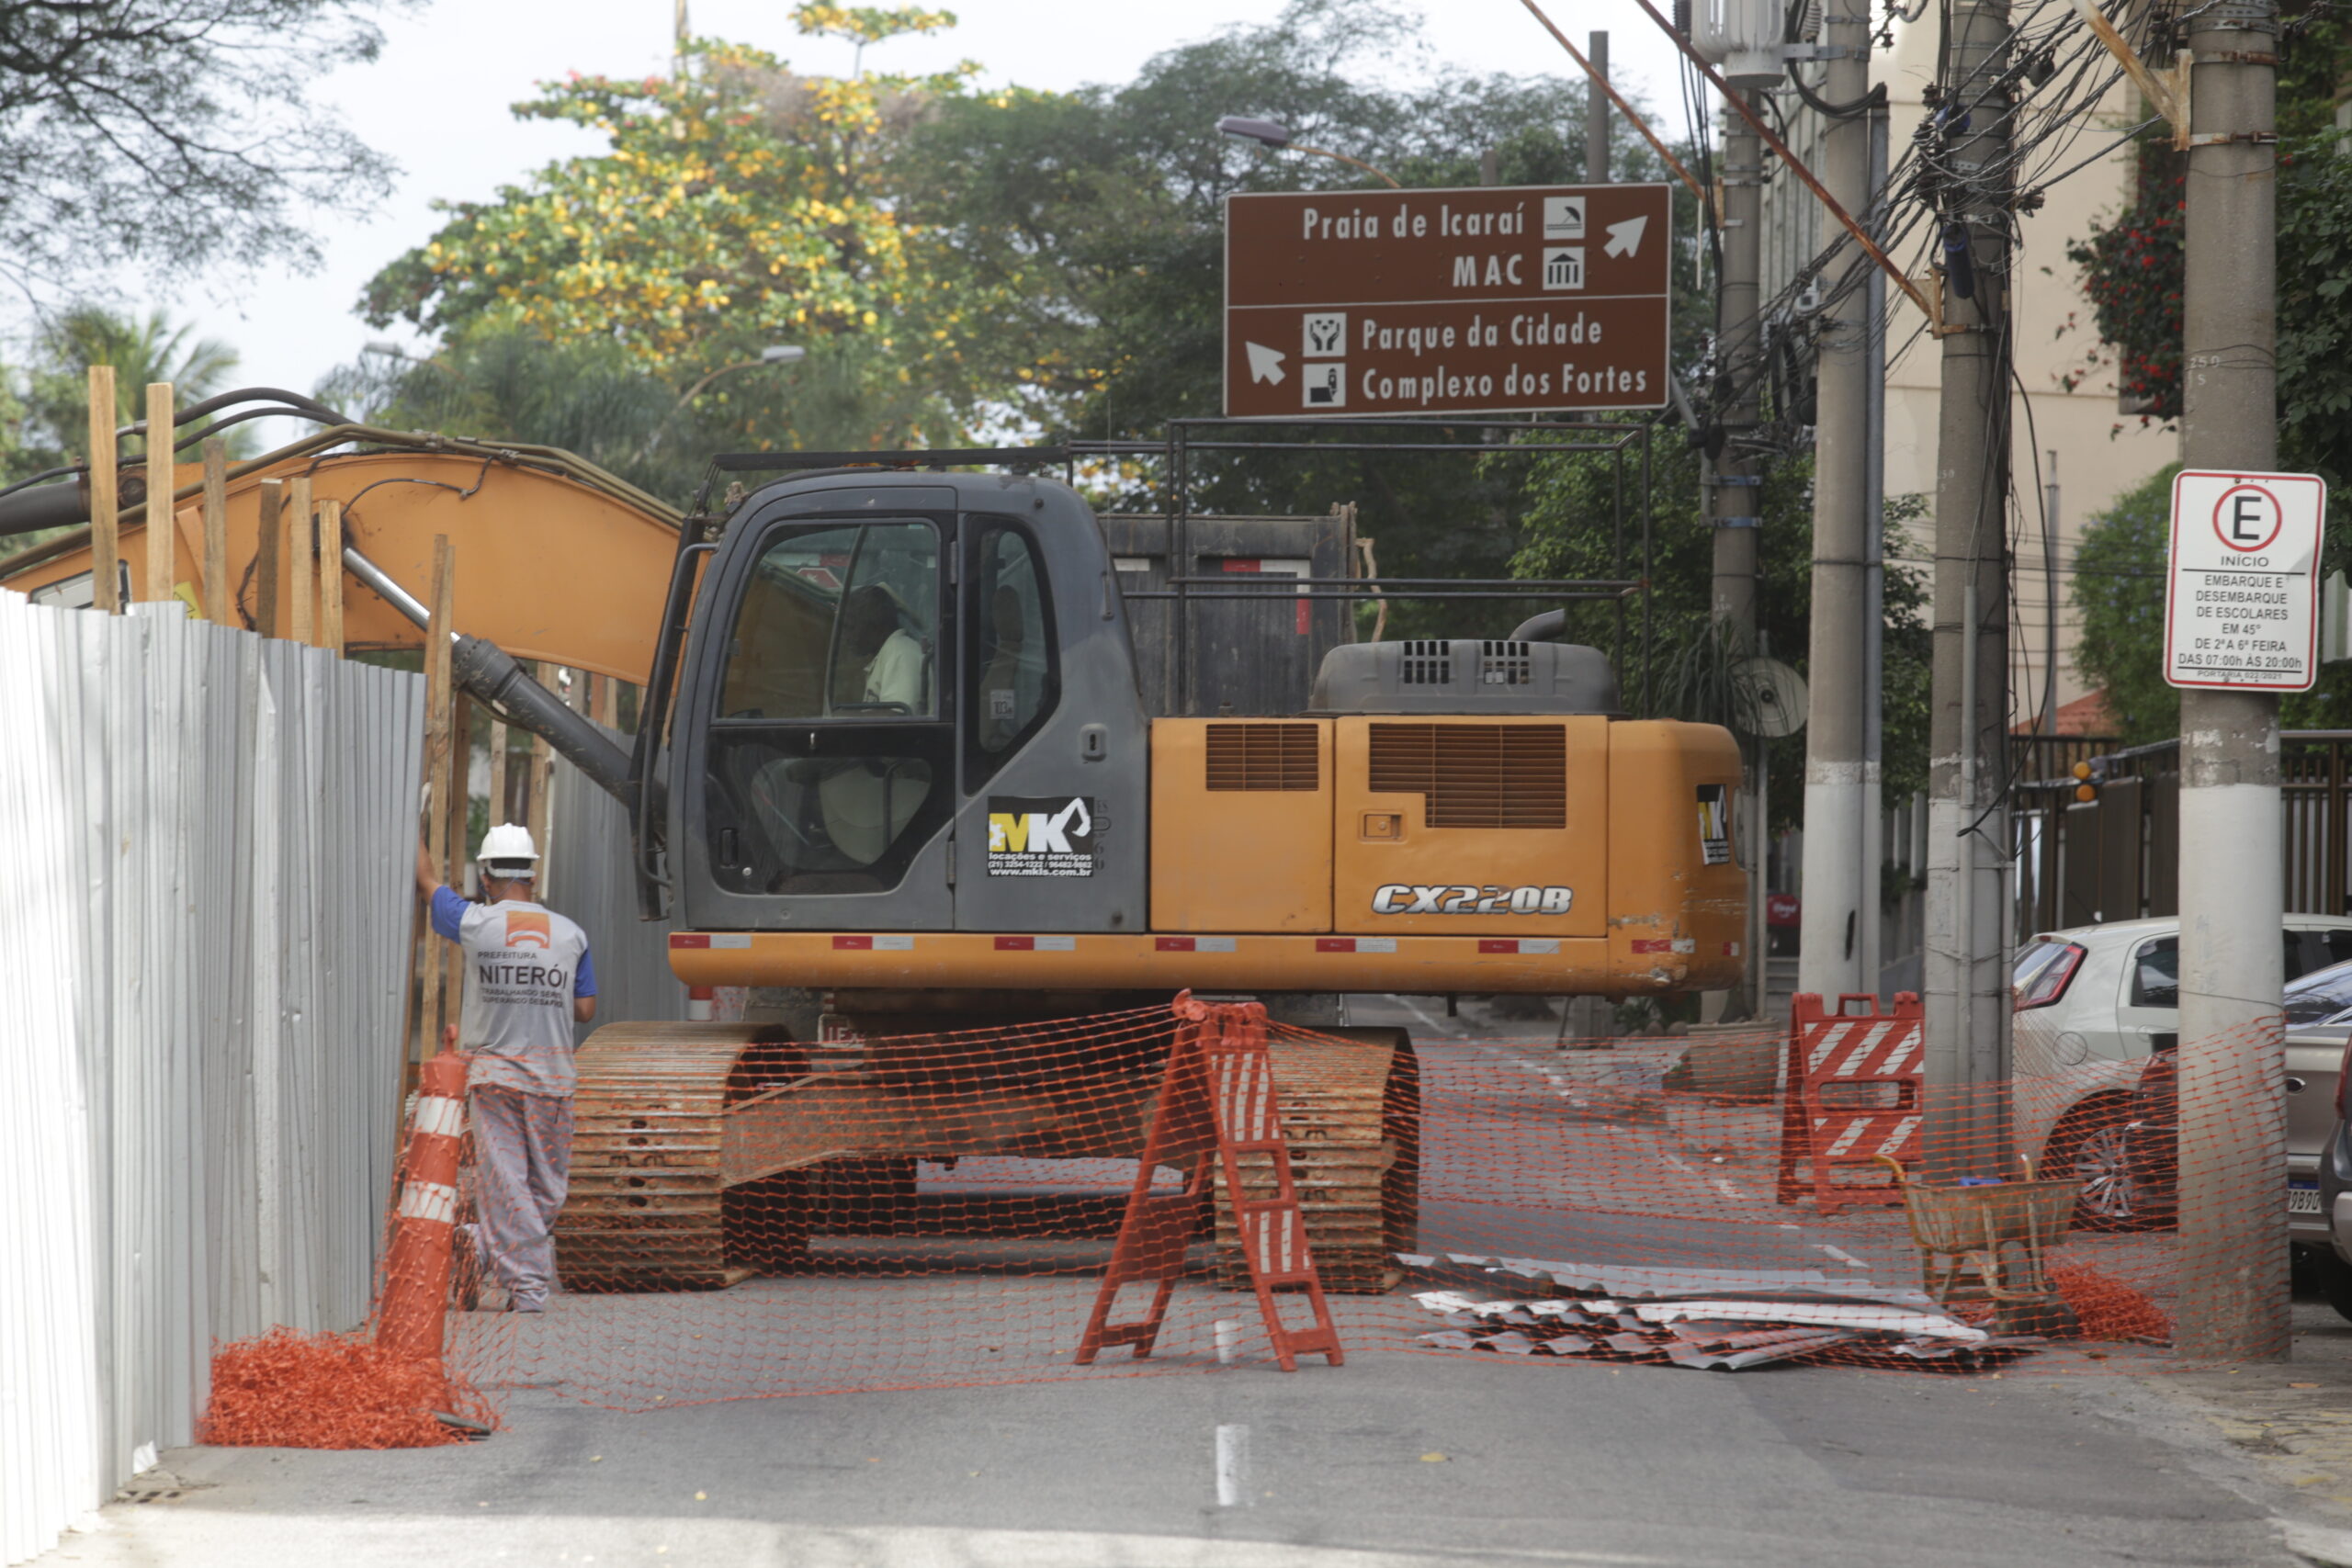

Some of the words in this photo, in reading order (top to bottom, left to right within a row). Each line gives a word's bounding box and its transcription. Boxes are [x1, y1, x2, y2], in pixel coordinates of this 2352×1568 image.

[1304, 208, 1379, 240] Praia
[1392, 203, 1427, 238] de
[1441, 201, 1525, 236] Icaraí
[1453, 254, 1522, 288] MAC
[1363, 319, 1455, 356] Parque
[1467, 314, 1498, 348] da
[1510, 311, 1602, 346] Cidade
[1363, 366, 1493, 405] Complexo
[1504, 363, 1550, 396] dos
[1563, 363, 1647, 395] Fortes
[2233, 495, 2262, 540] E
[2221, 554, 2269, 567] INÍCIO
[2204, 574, 2271, 588] EMBARQUE
[2276, 577, 2284, 589] E
[2196, 590, 2288, 604] DESEMBARQUE
[2197, 606, 2213, 618] DE
[2216, 607, 2289, 621] ESCOLARES
[2222, 623, 2239, 635] EM
[2195, 637, 2211, 649] DE
[2226, 638, 2234, 650] A
[2252, 640, 2287, 652] FEIRA
[2178, 653, 2202, 665] DAS
[2206, 654, 2243, 667] 07:00h
[2266, 656, 2301, 669] 20:00h
[2197, 670, 2242, 679] PORTARIA
[989, 797, 1091, 852] MK
[989, 852, 1036, 862] locações
[1047, 852, 1092, 862] serviços
[1373, 884, 1573, 914] CX220B
[477, 951, 537, 960] PREFEITURA
[479, 963, 569, 989] NITERÓI
